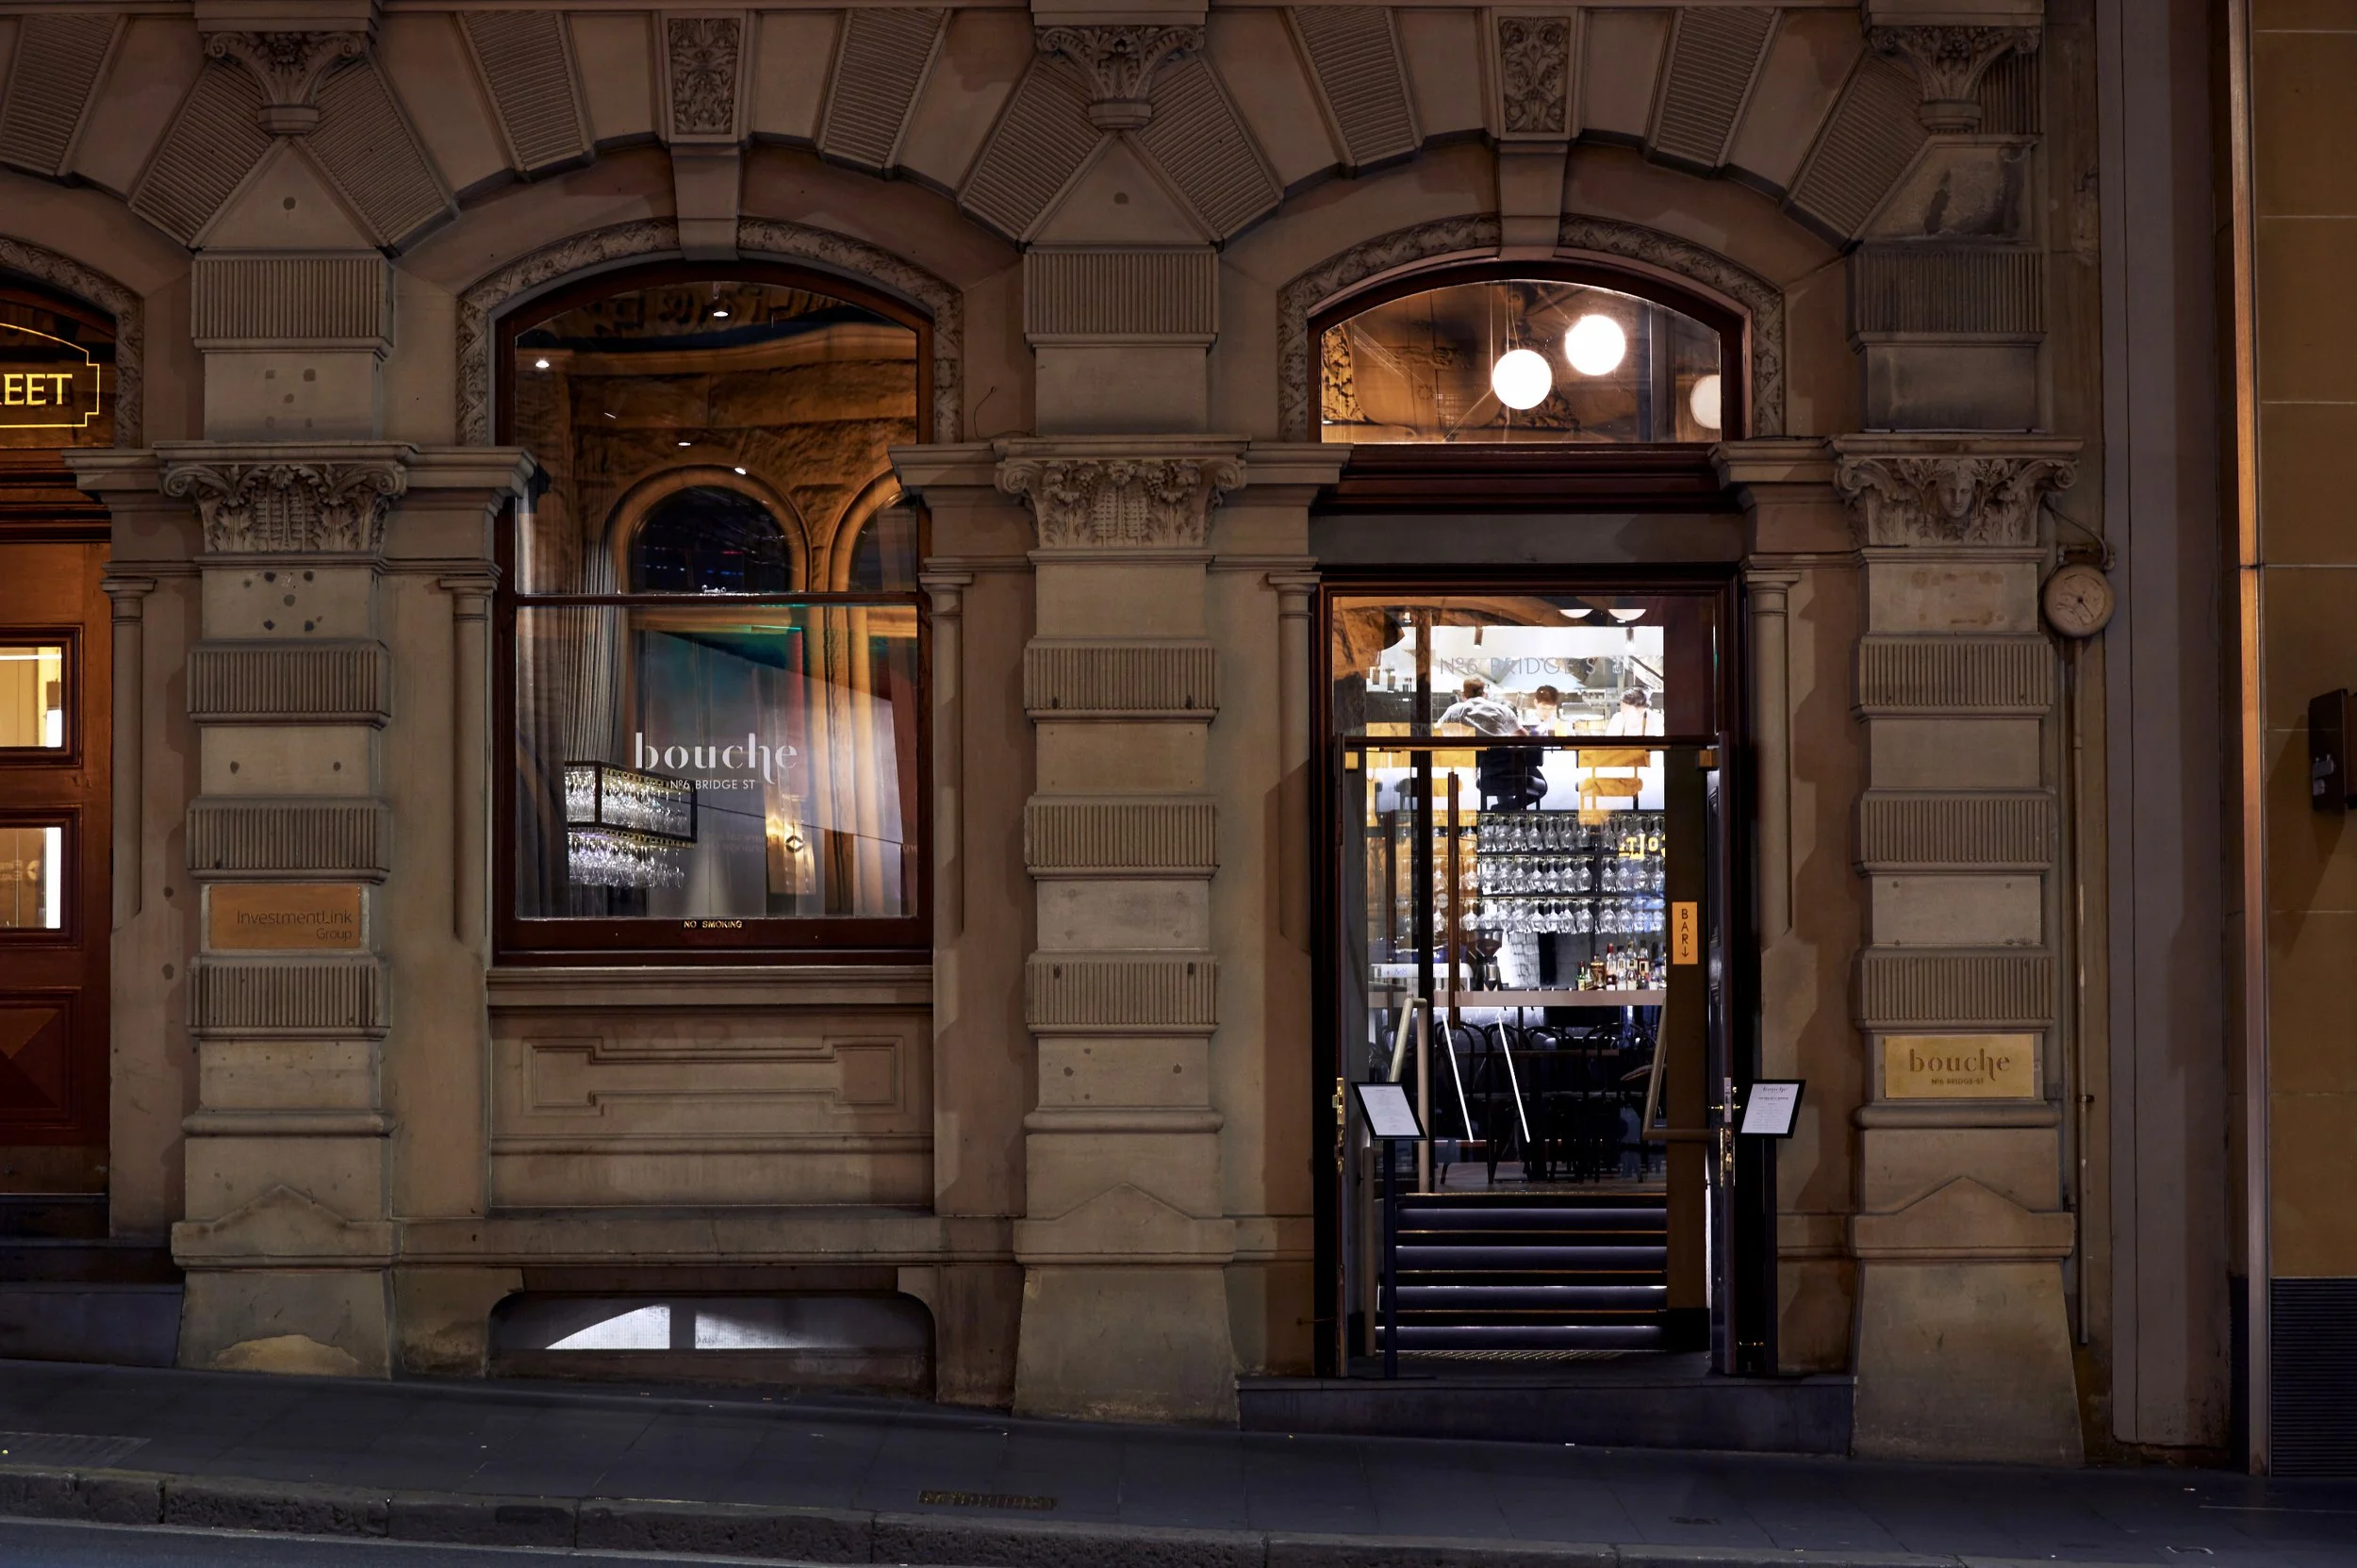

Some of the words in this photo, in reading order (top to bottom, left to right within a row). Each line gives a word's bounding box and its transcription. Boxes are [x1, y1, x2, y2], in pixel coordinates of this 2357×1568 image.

[0, 372, 74, 405] EET
[1491, 657, 1575, 675] BRIDGE
[635, 732, 798, 784] bouche
[695, 780, 738, 790] BRIDGE
[743, 780, 755, 790] ST
[237, 910, 353, 925] InvestmentLink
[684, 919, 698, 929] NO
[701, 919, 743, 929] SMOKING
[316, 928, 353, 941] Group
[1909, 1048, 2011, 1081] bouche
